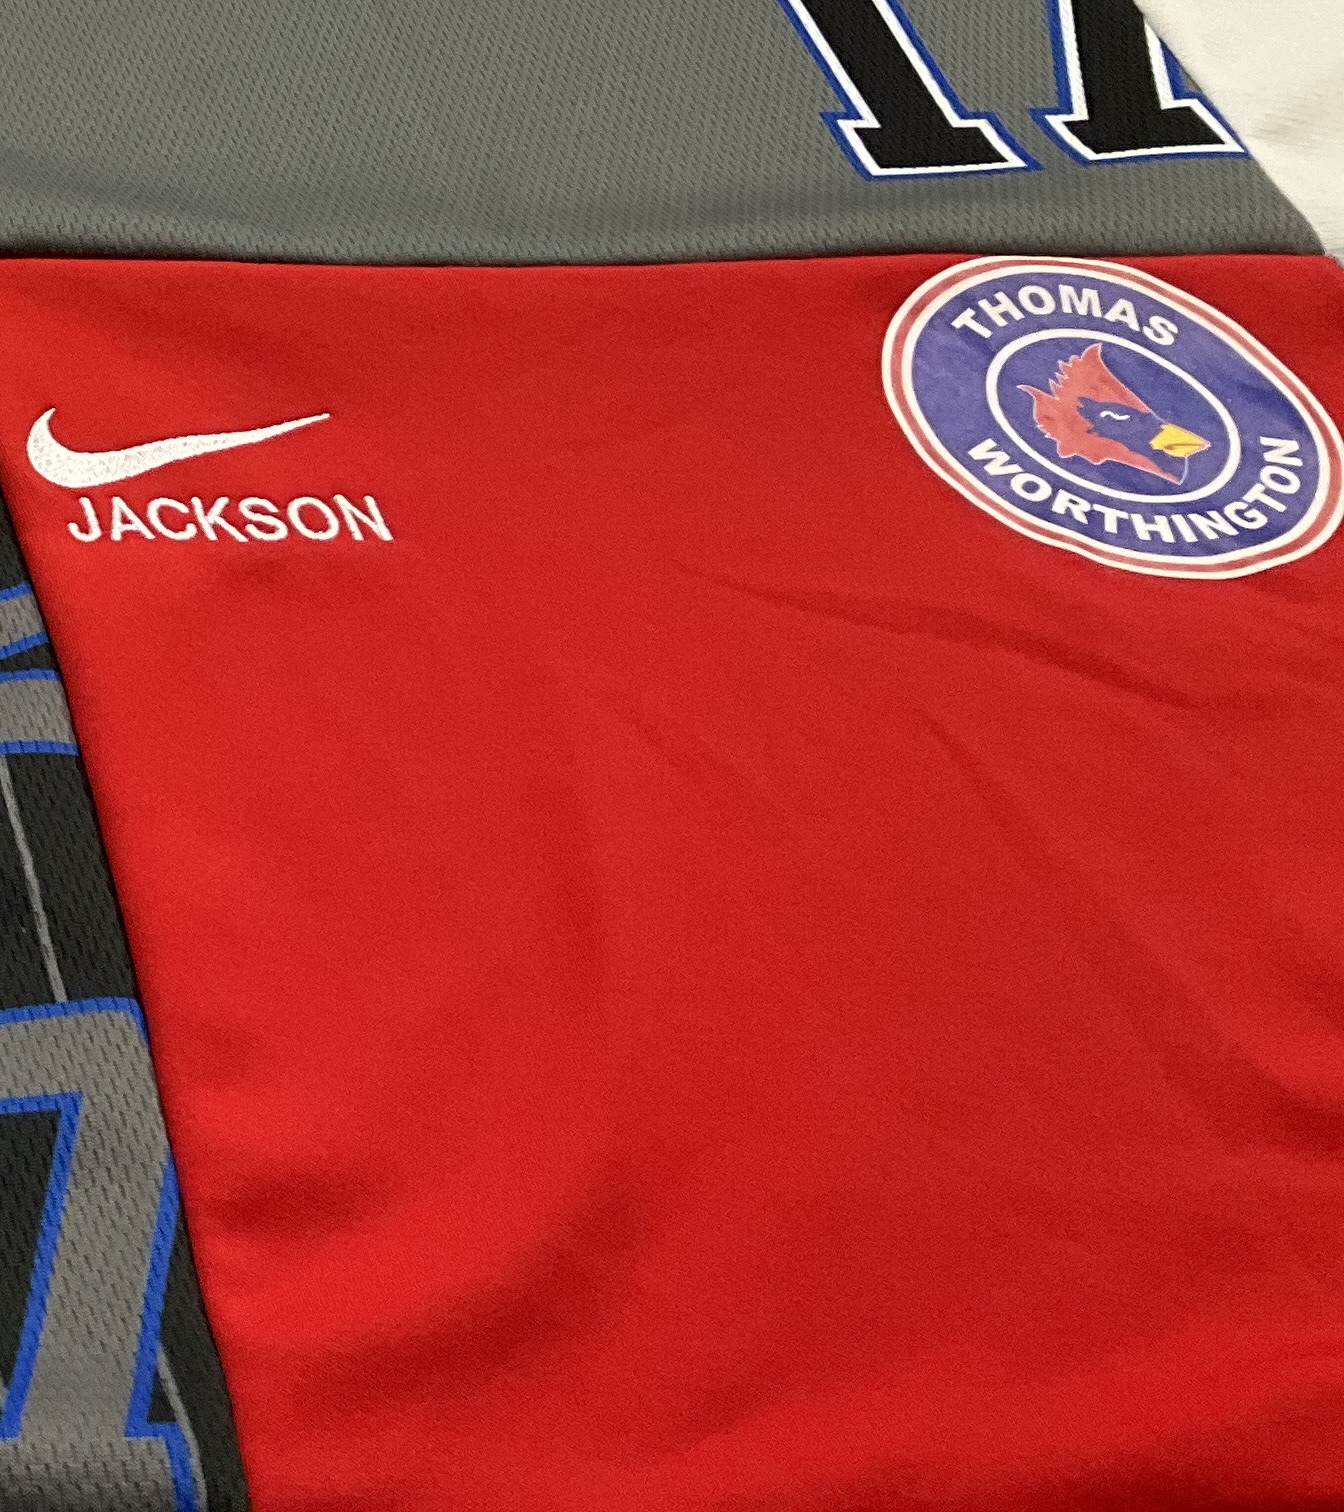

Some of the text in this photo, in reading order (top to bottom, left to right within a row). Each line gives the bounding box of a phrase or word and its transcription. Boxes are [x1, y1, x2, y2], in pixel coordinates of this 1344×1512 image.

[952, 282, 1182, 349] THOMAS
[66, 494, 393, 544] JACKSON
[966, 433, 1303, 547] WORTHINGTON
